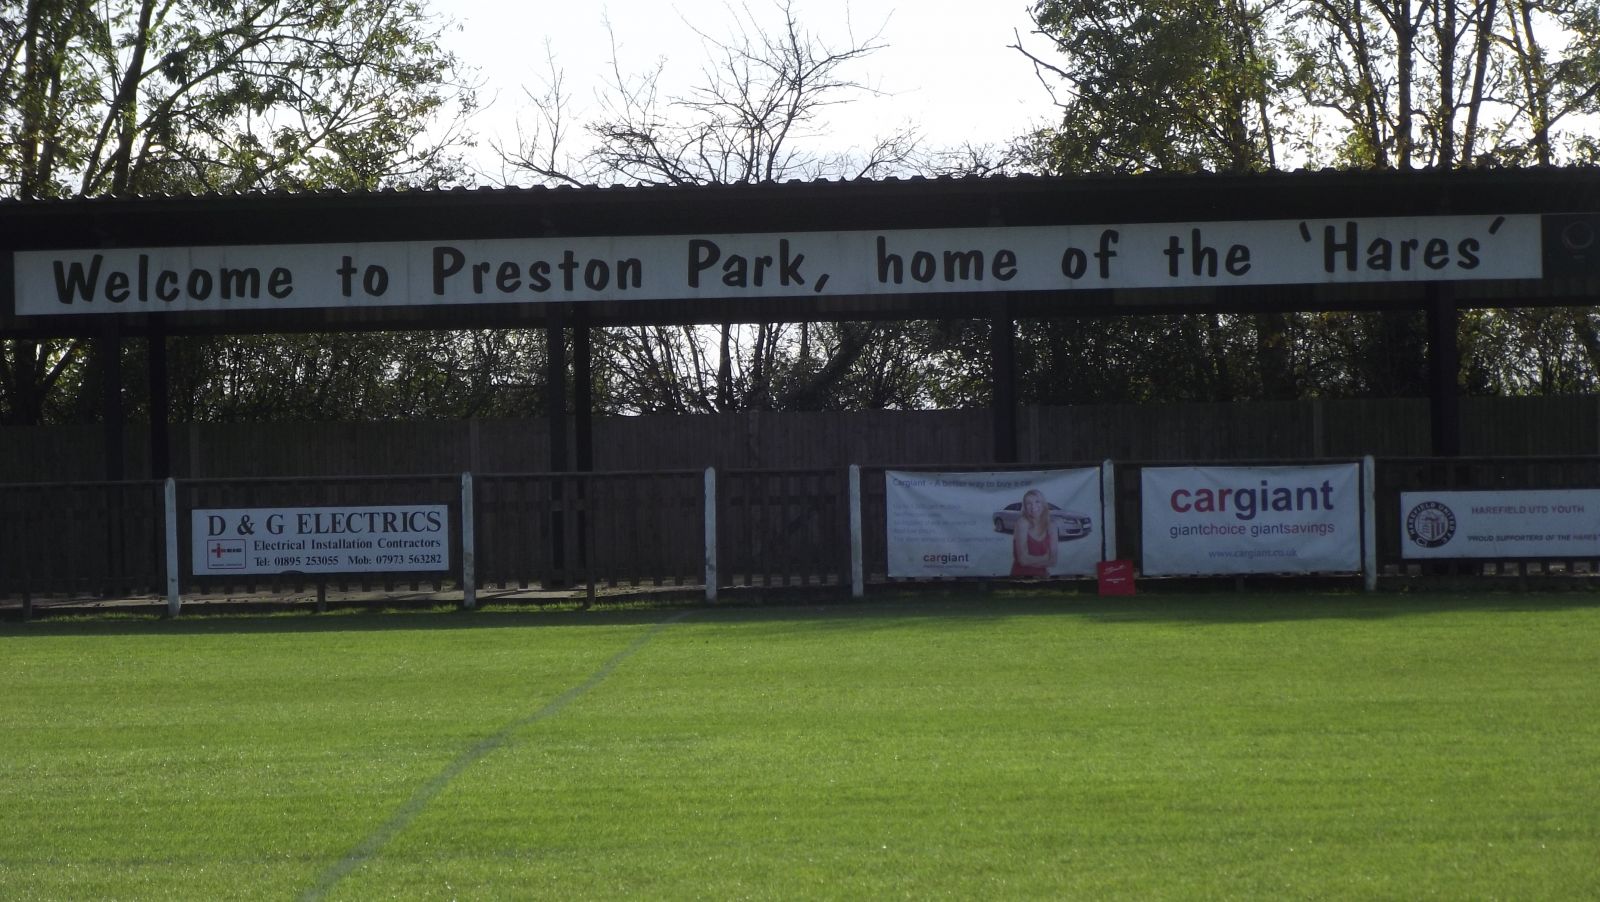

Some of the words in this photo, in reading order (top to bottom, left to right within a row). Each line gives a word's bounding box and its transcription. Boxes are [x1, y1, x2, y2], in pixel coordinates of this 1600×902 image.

[53, 254, 293, 305] Welcome
[336, 255, 389, 298] to
[432, 246, 643, 296] Preston
[687, 238, 830, 293] Park,
[876, 235, 1018, 284] home
[1061, 229, 1120, 280] of
[1163, 228, 1252, 278] the
[942, 478, 969, 488] better
[1170, 480, 1335, 521] cargiant
[1471, 505, 1526, 515] HAREFIELD
[1528, 505, 1548, 514] UTD
[1551, 504, 1585, 514] YOUTH
[207, 515, 227, 537] D
[236, 514, 256, 536] &
[265, 513, 285, 536] G
[296, 511, 442, 535] ELECTRICS
[1169, 523, 1247, 540] giantchoice
[1250, 522, 1335, 539] giantsavings
[253, 539, 306, 551] Electrical
[311, 538, 373, 550] Installation
[377, 537, 441, 549] Contractors
[1495, 534, 1544, 542] SUPPORTERS
[1545, 534, 1555, 542] OF
[1556, 534, 1572, 542] THE
[254, 556, 271, 567] Tel:
[274, 556, 302, 567] 01895
[305, 555, 339, 566] 253055
[347, 555, 373, 566] Mob:
[376, 554, 404, 565] 07973
[408, 553, 442, 564] 563282
[922, 553, 969, 565] cargiant
